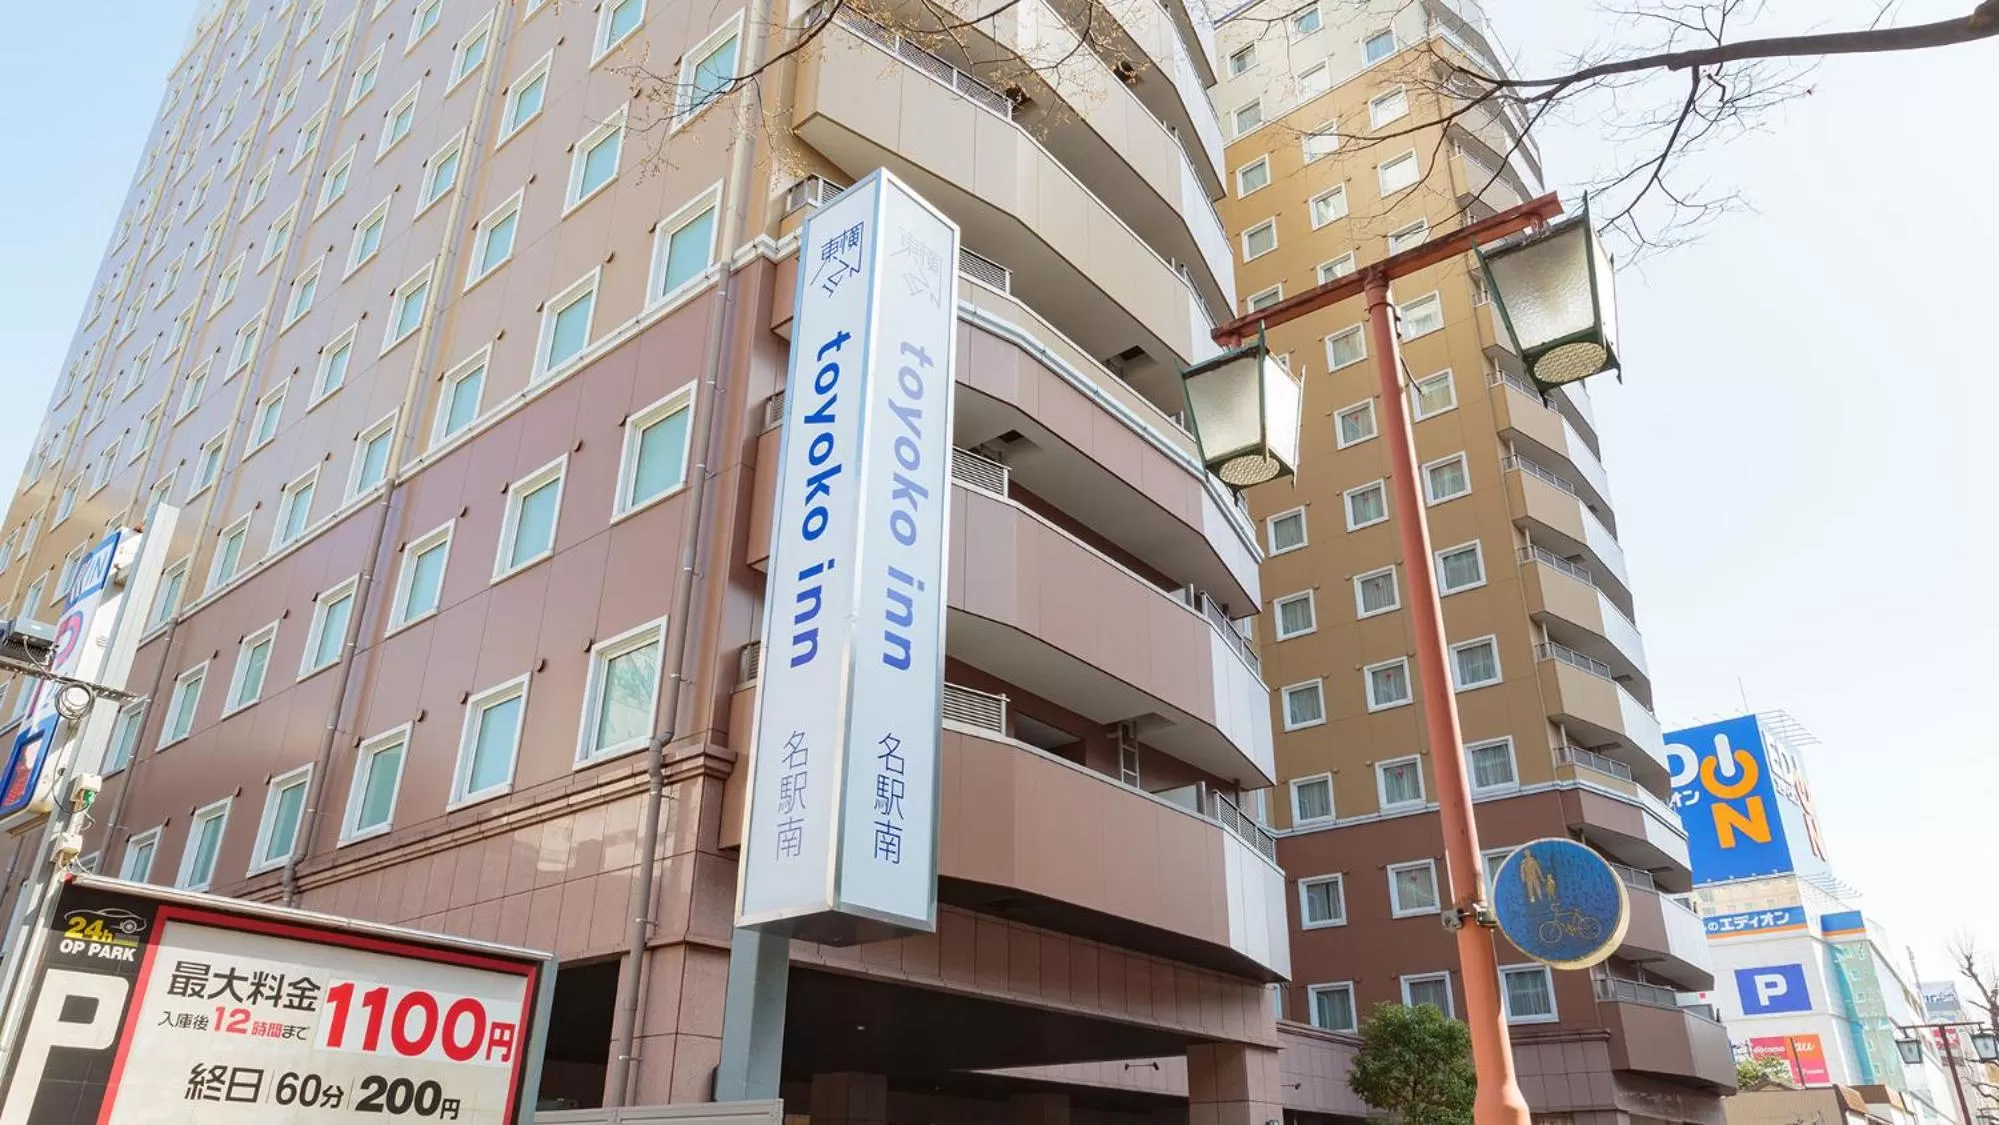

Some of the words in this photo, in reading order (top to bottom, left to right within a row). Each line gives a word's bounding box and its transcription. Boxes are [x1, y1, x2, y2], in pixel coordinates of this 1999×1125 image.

[802, 330, 851, 541] toyoko
[888, 341, 934, 547] toyoko
[790, 558, 835, 669] inn
[882, 565, 925, 671] inn
[776, 730, 808, 864] 名駅南
[873, 731, 905, 865] 名駅南
[59, 939, 87, 955] OP
[87, 943, 137, 962] PARK
[64, 915, 114, 943] 24h
[1704, 911, 1790, 932] のエディオン
[166, 960, 321, 1012] 最大料金
[326, 981, 516, 1063] 1100円
[1754, 973, 1788, 1006] P
[0, 968, 130, 1125] P
[184, 1062, 265, 1103] 終日
[275, 1071, 345, 1109] 60分
[355, 1074, 461, 1120] 200円
[1794, 1041, 1816, 1051] au
